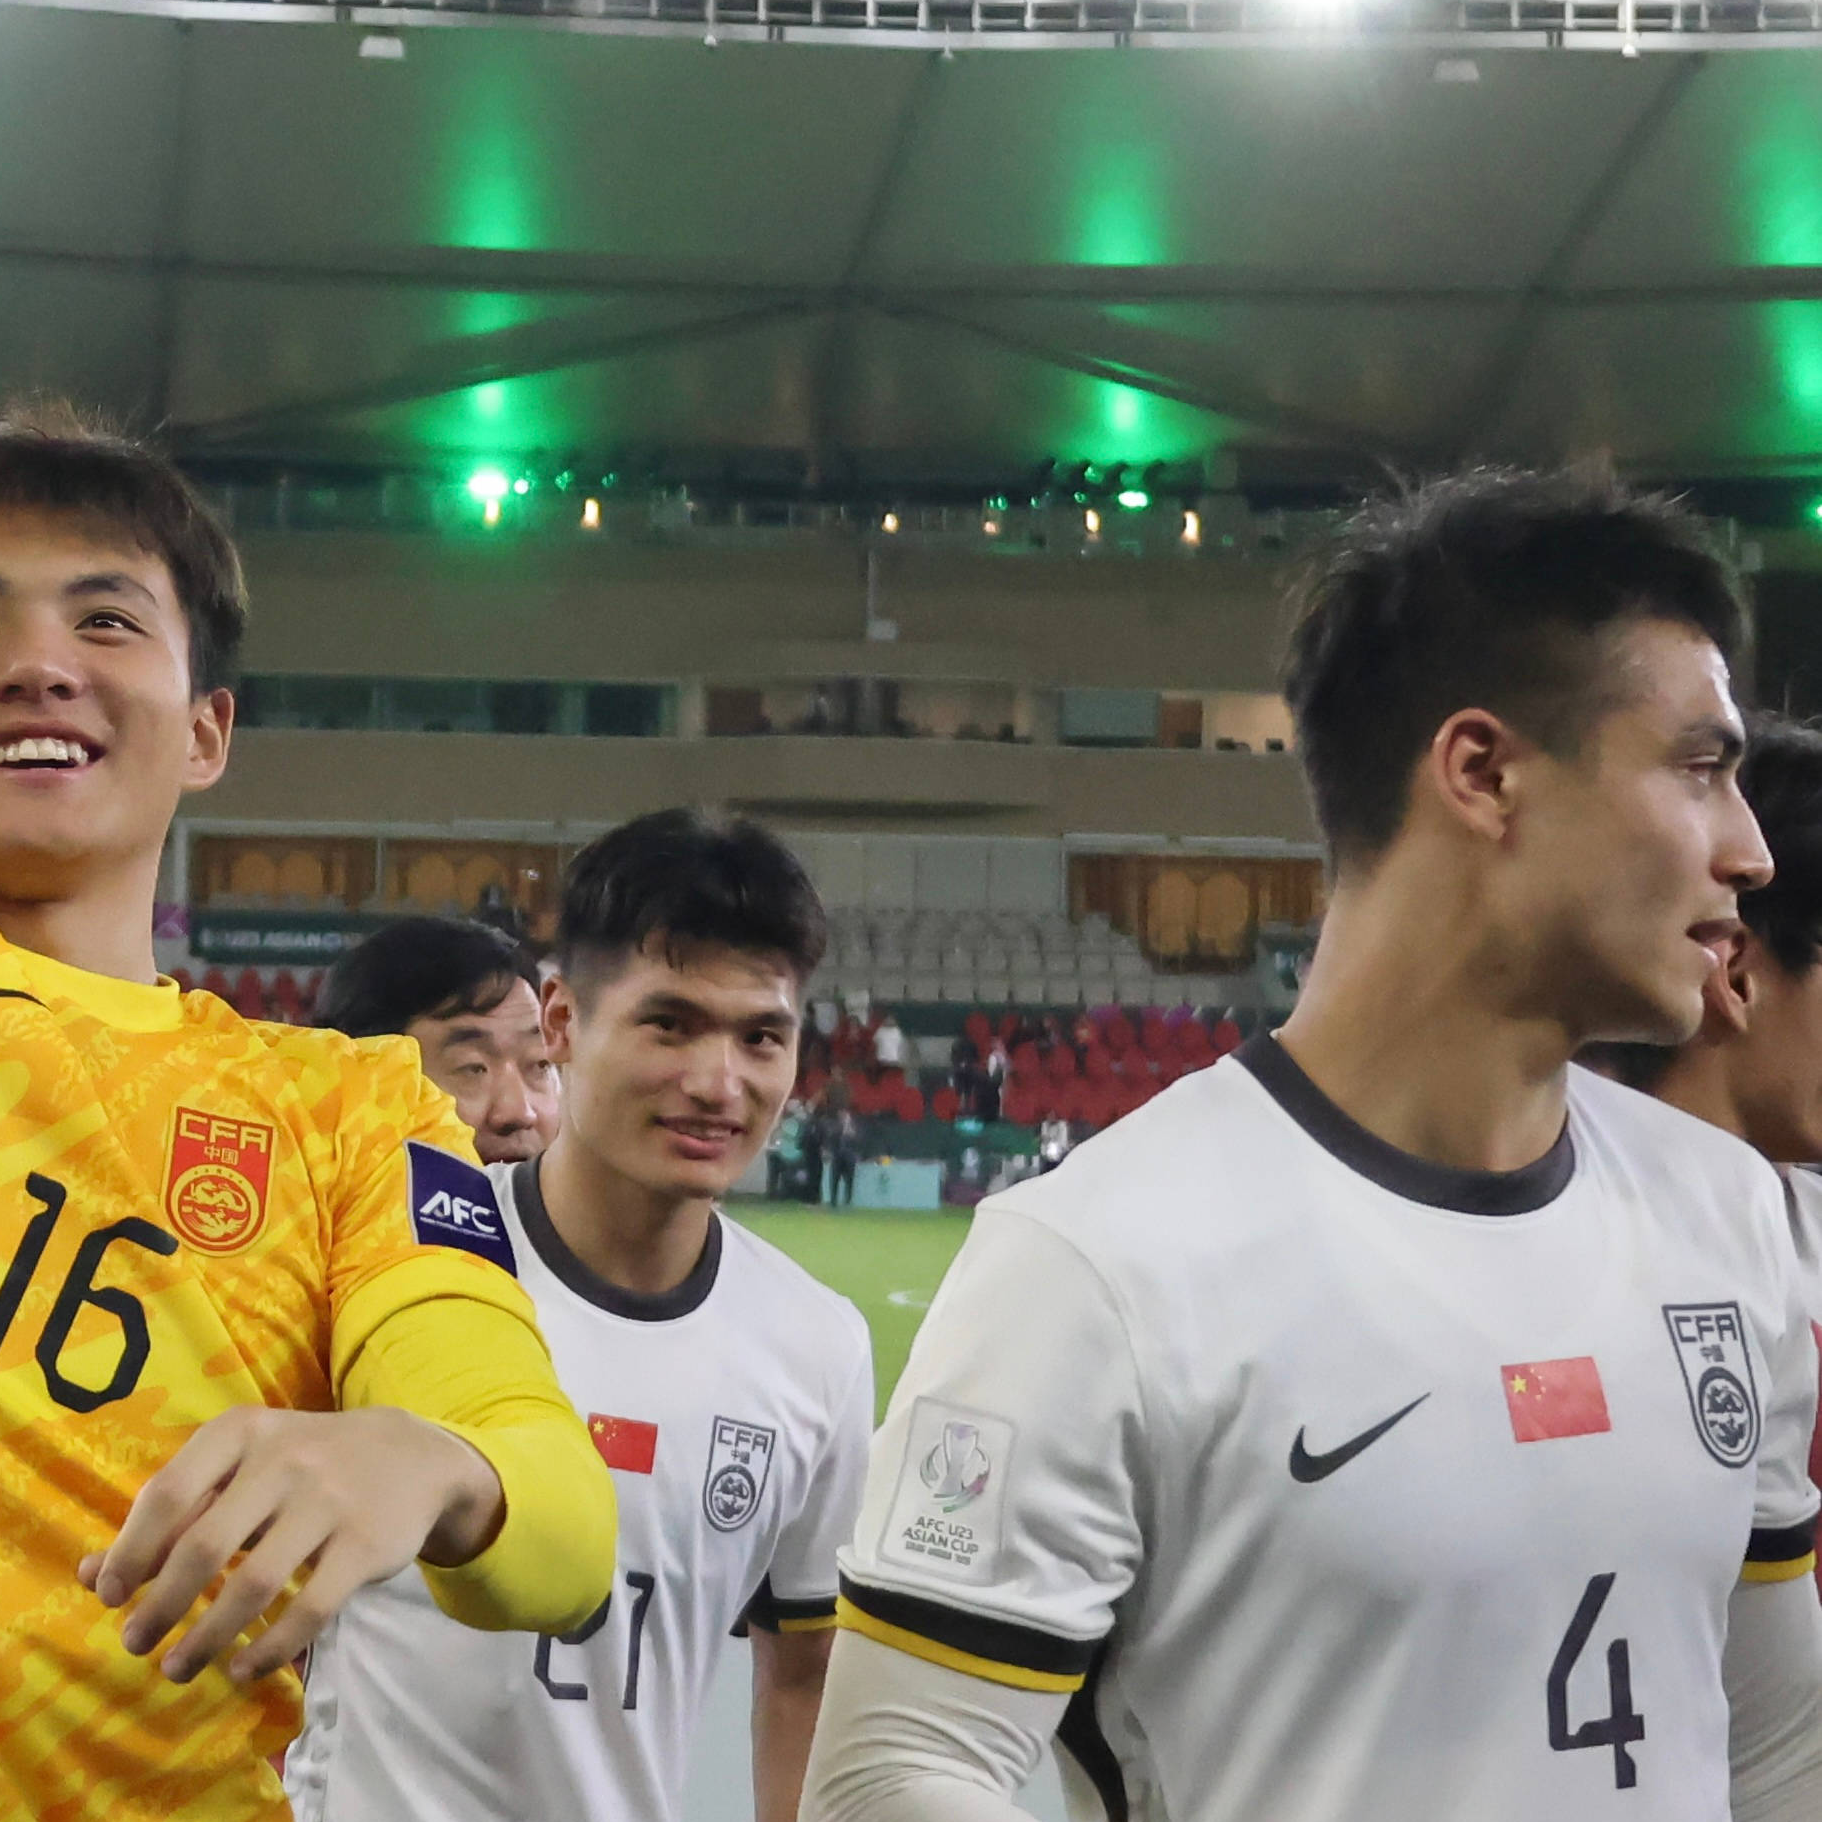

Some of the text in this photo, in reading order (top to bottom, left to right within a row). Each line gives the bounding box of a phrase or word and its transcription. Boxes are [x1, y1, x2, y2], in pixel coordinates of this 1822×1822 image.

[179, 1111, 269, 1154] CFA
[419, 1190, 496, 1233] AFC
[1674, 1314, 1739, 1344] CFA
[718, 1424, 770, 1454] CFA
[902, 1527, 948, 1548] ASIAN
[915, 1516, 945, 1533] AFC
[949, 1523, 973, 1540] U23
[950, 1539, 979, 1554] CUP
[1547, 1572, 1645, 1790] 4
